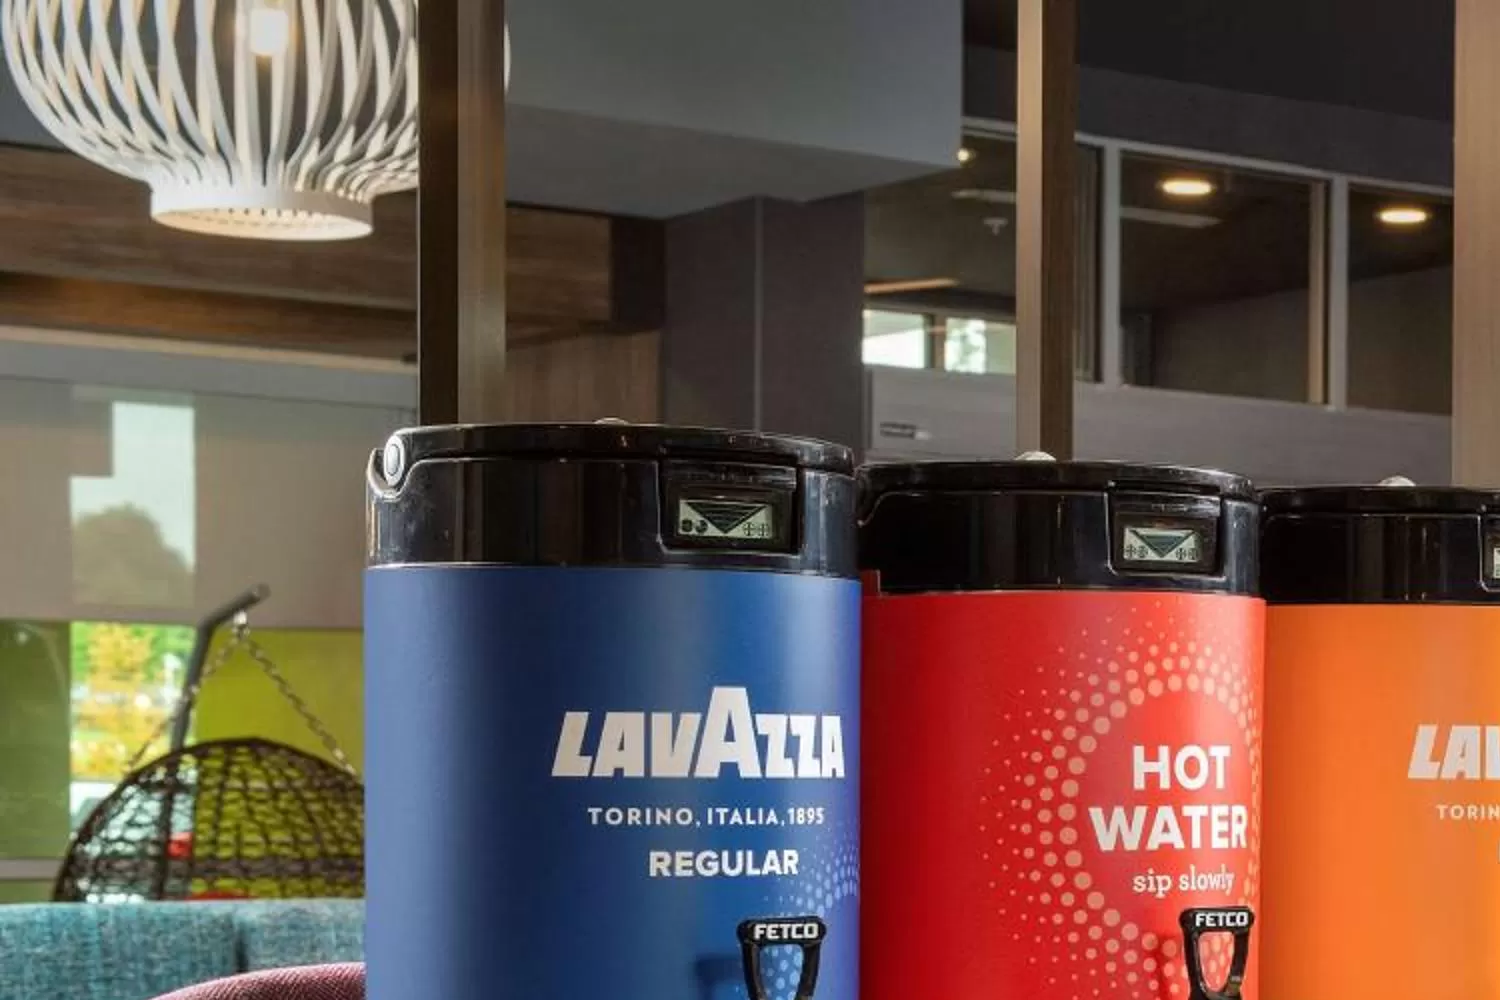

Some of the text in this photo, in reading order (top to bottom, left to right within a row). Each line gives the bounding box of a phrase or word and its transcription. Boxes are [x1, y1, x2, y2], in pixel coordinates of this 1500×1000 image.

[551, 686, 845, 779] LAVAZZA
[1132, 744, 1231, 790] HOT
[587, 807, 701, 829] TORINO,
[788, 806, 824, 825] 1895
[1088, 804, 1248, 851] WATER
[649, 849, 799, 877] REGULAR
[1132, 864, 1234, 898] sip slowly
[754, 923, 819, 940] FETCO
[1195, 911, 1249, 928] FETCO
